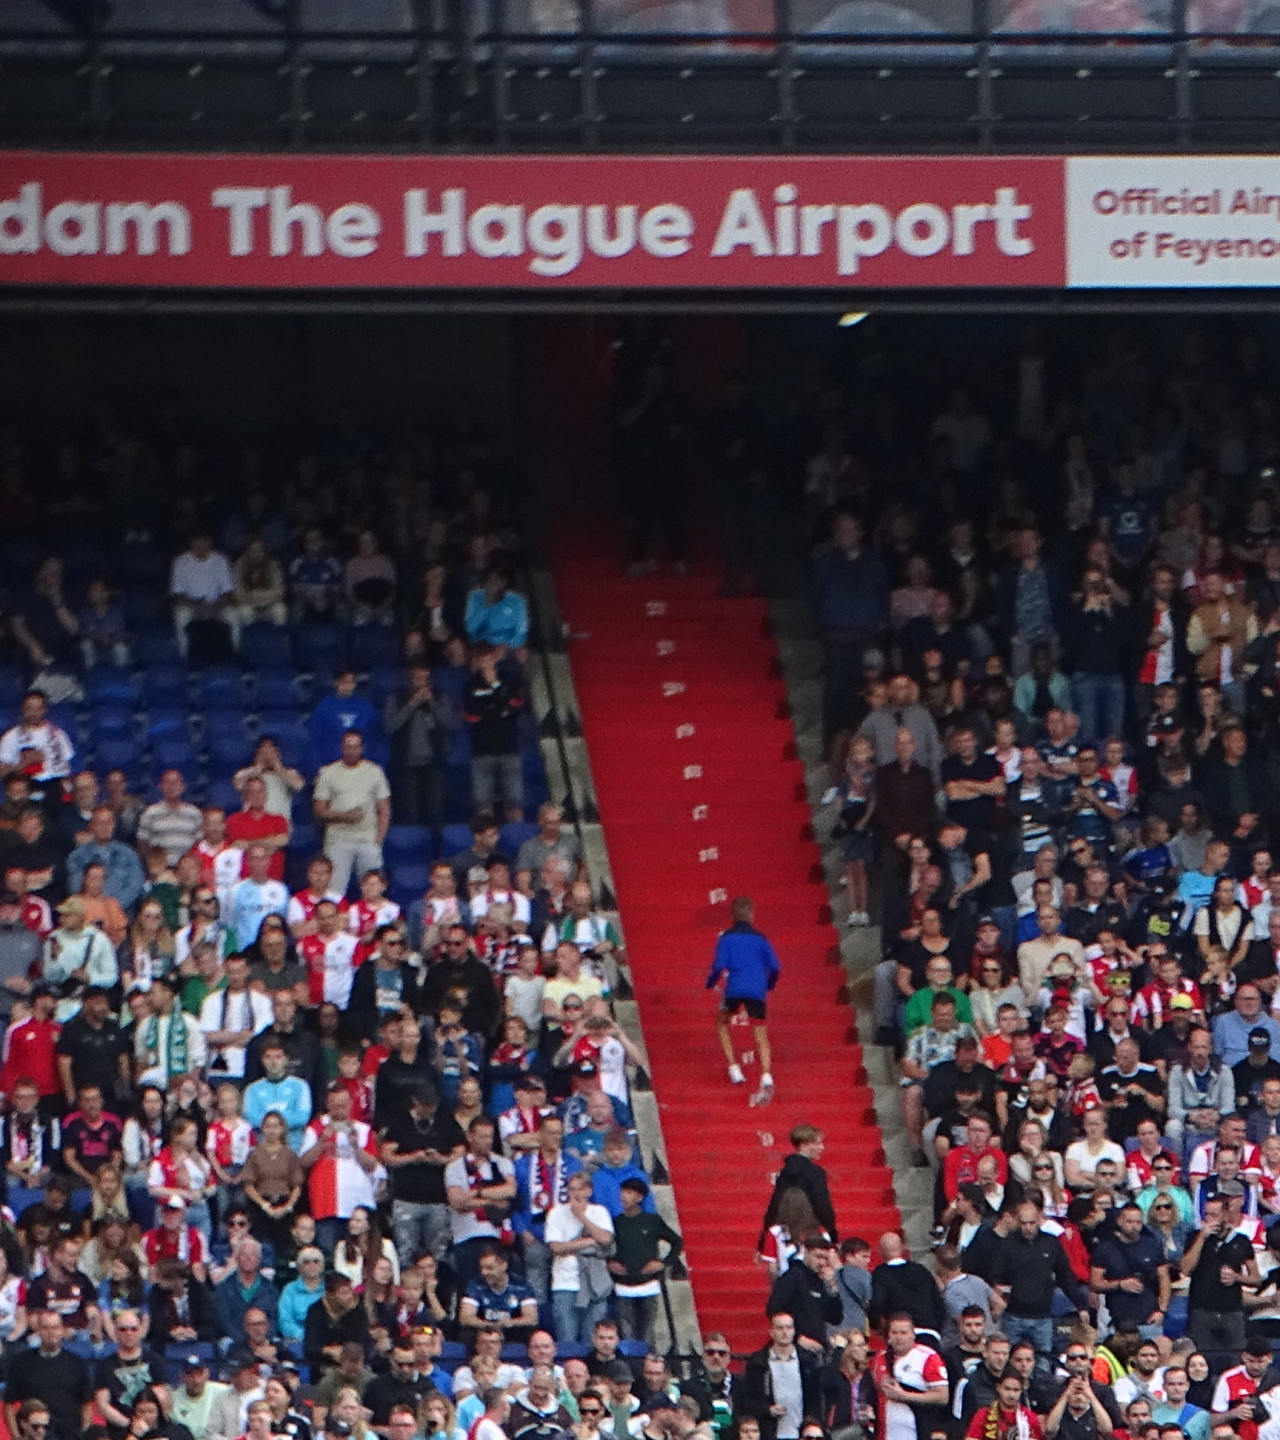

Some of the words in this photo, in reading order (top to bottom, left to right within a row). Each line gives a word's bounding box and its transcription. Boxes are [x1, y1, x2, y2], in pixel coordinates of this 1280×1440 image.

[1092, 187, 1221, 217] Official
[0, 183, 190, 257] dam
[212, 186, 380, 258] The
[404, 187, 694, 278] Hague
[712, 184, 1033, 276] Airport
[1109, 230, 1147, 260] of
